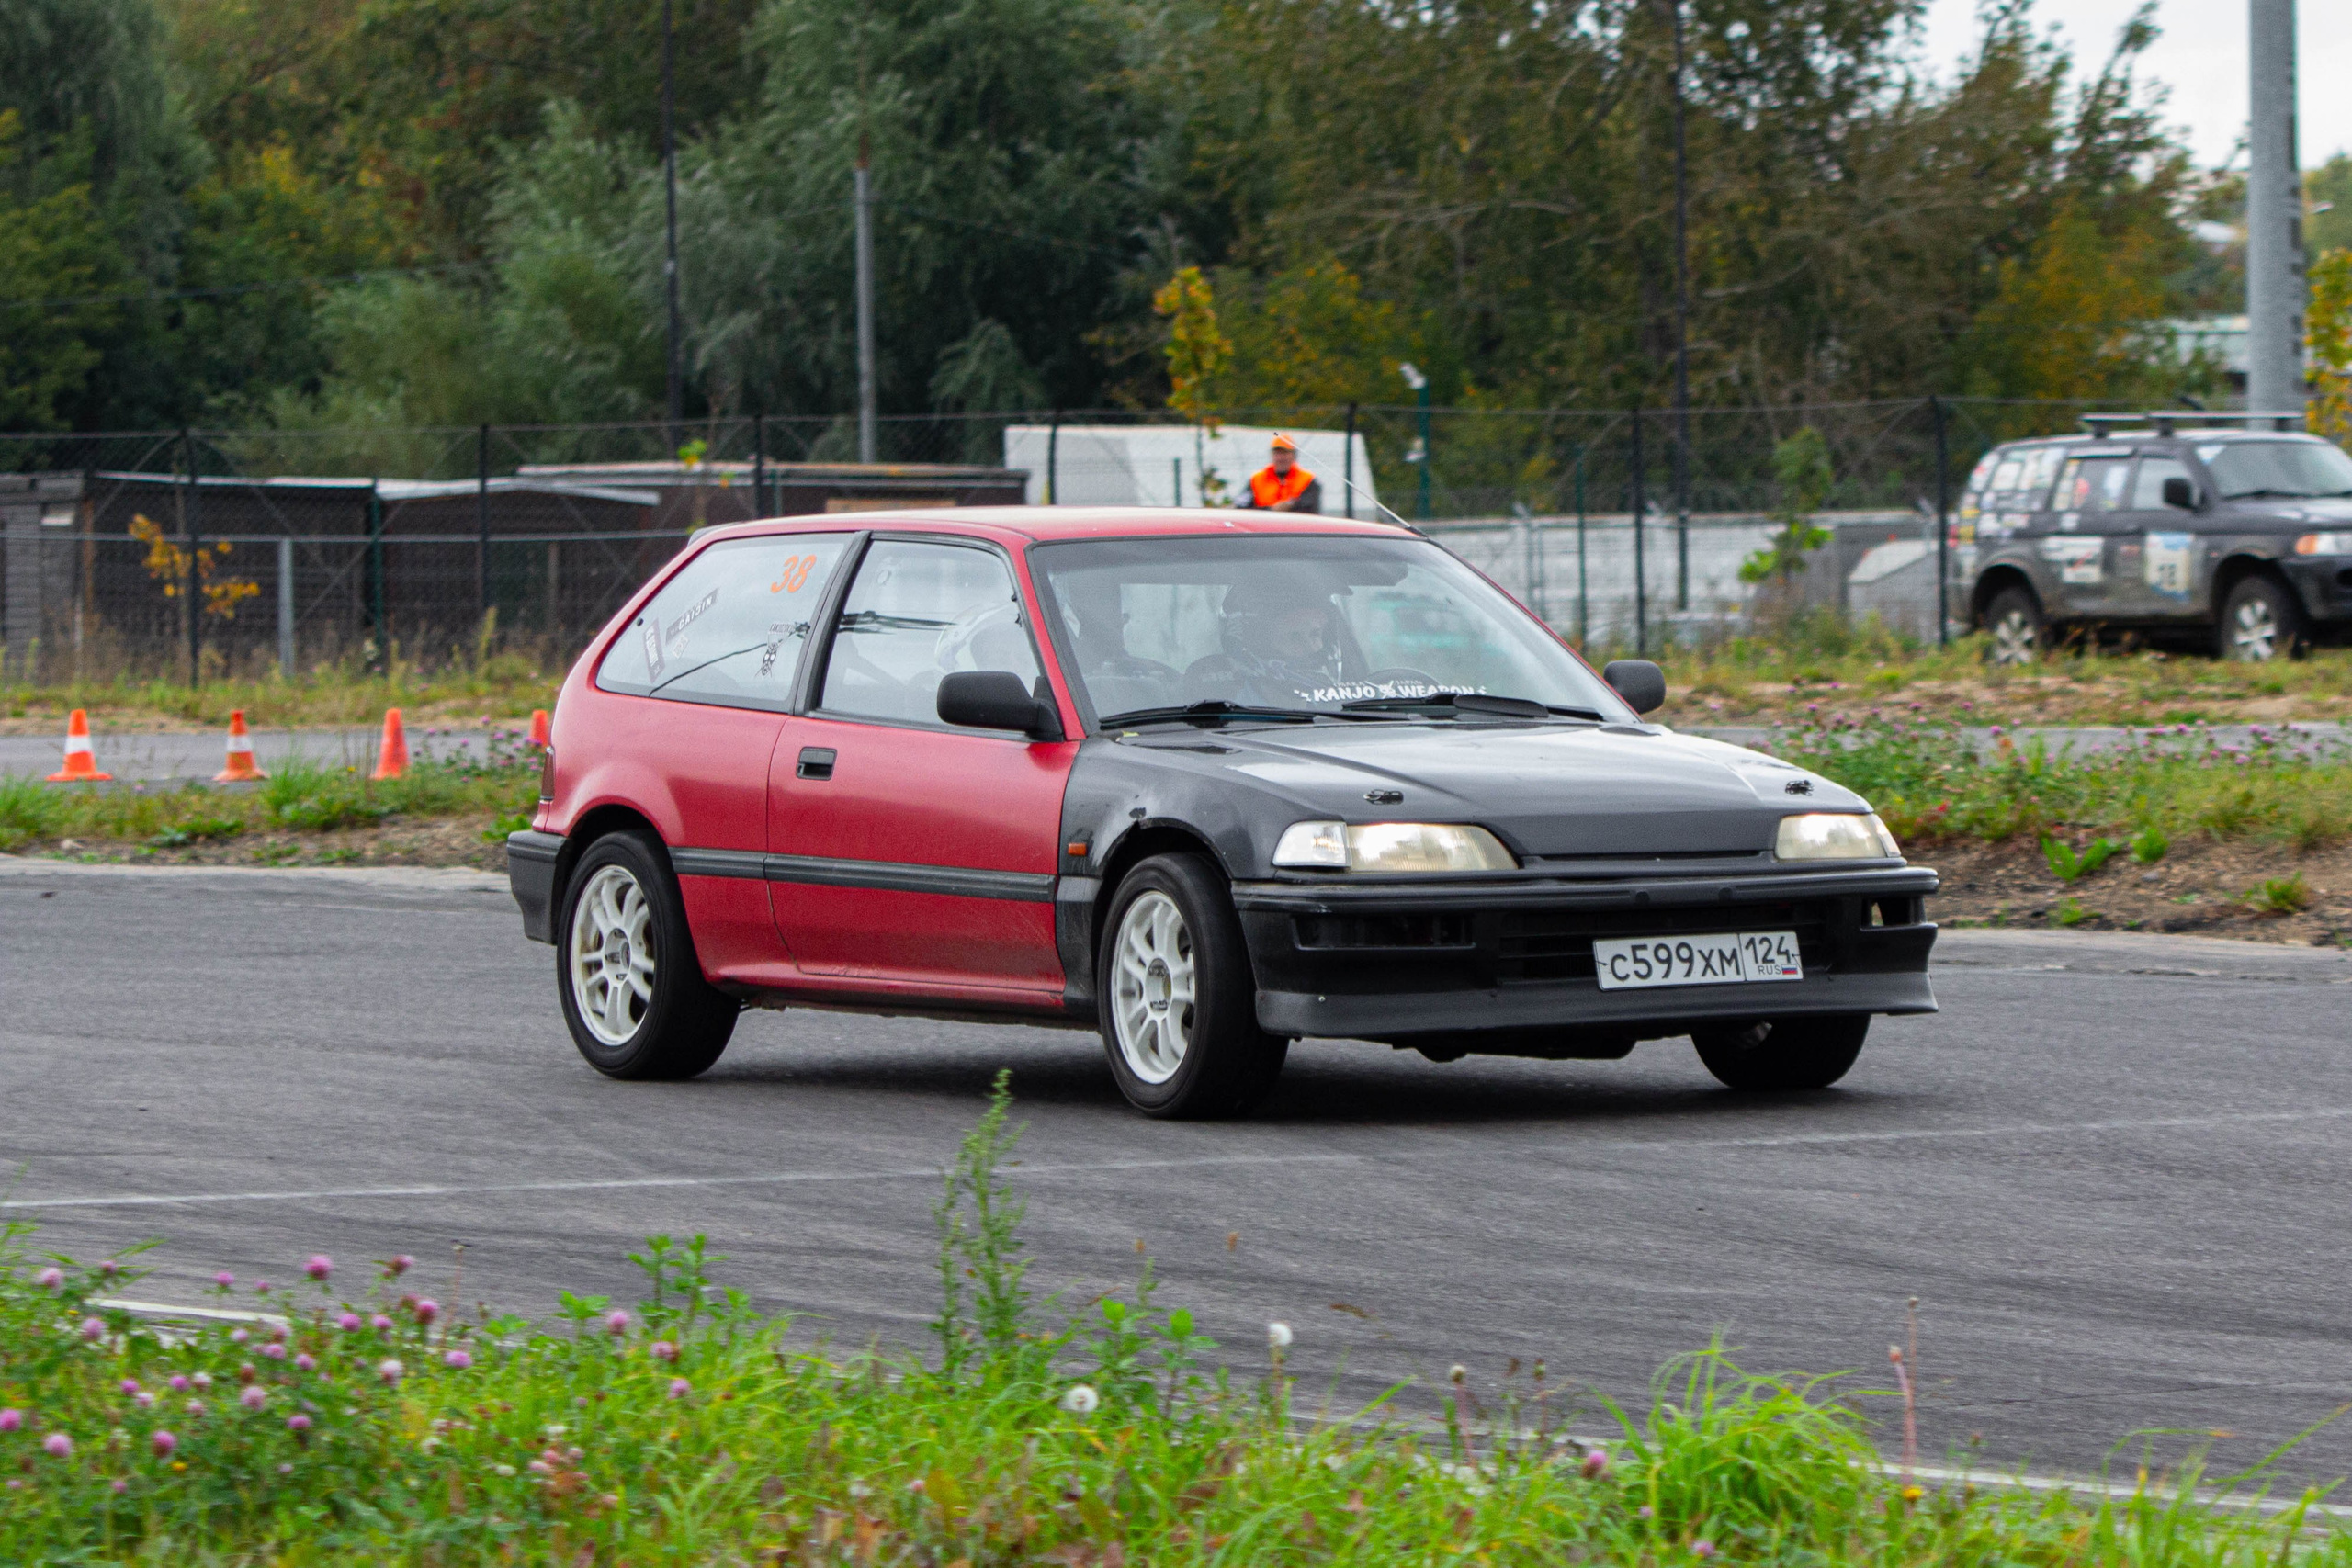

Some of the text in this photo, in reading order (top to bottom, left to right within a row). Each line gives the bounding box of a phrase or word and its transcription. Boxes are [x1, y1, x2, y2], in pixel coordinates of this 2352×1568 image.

[770, 554, 817, 593] 38
[1313, 685, 1376, 702] KANJO
[1745, 936, 1792, 964] 124
[1758, 964, 1781, 976] RUS
